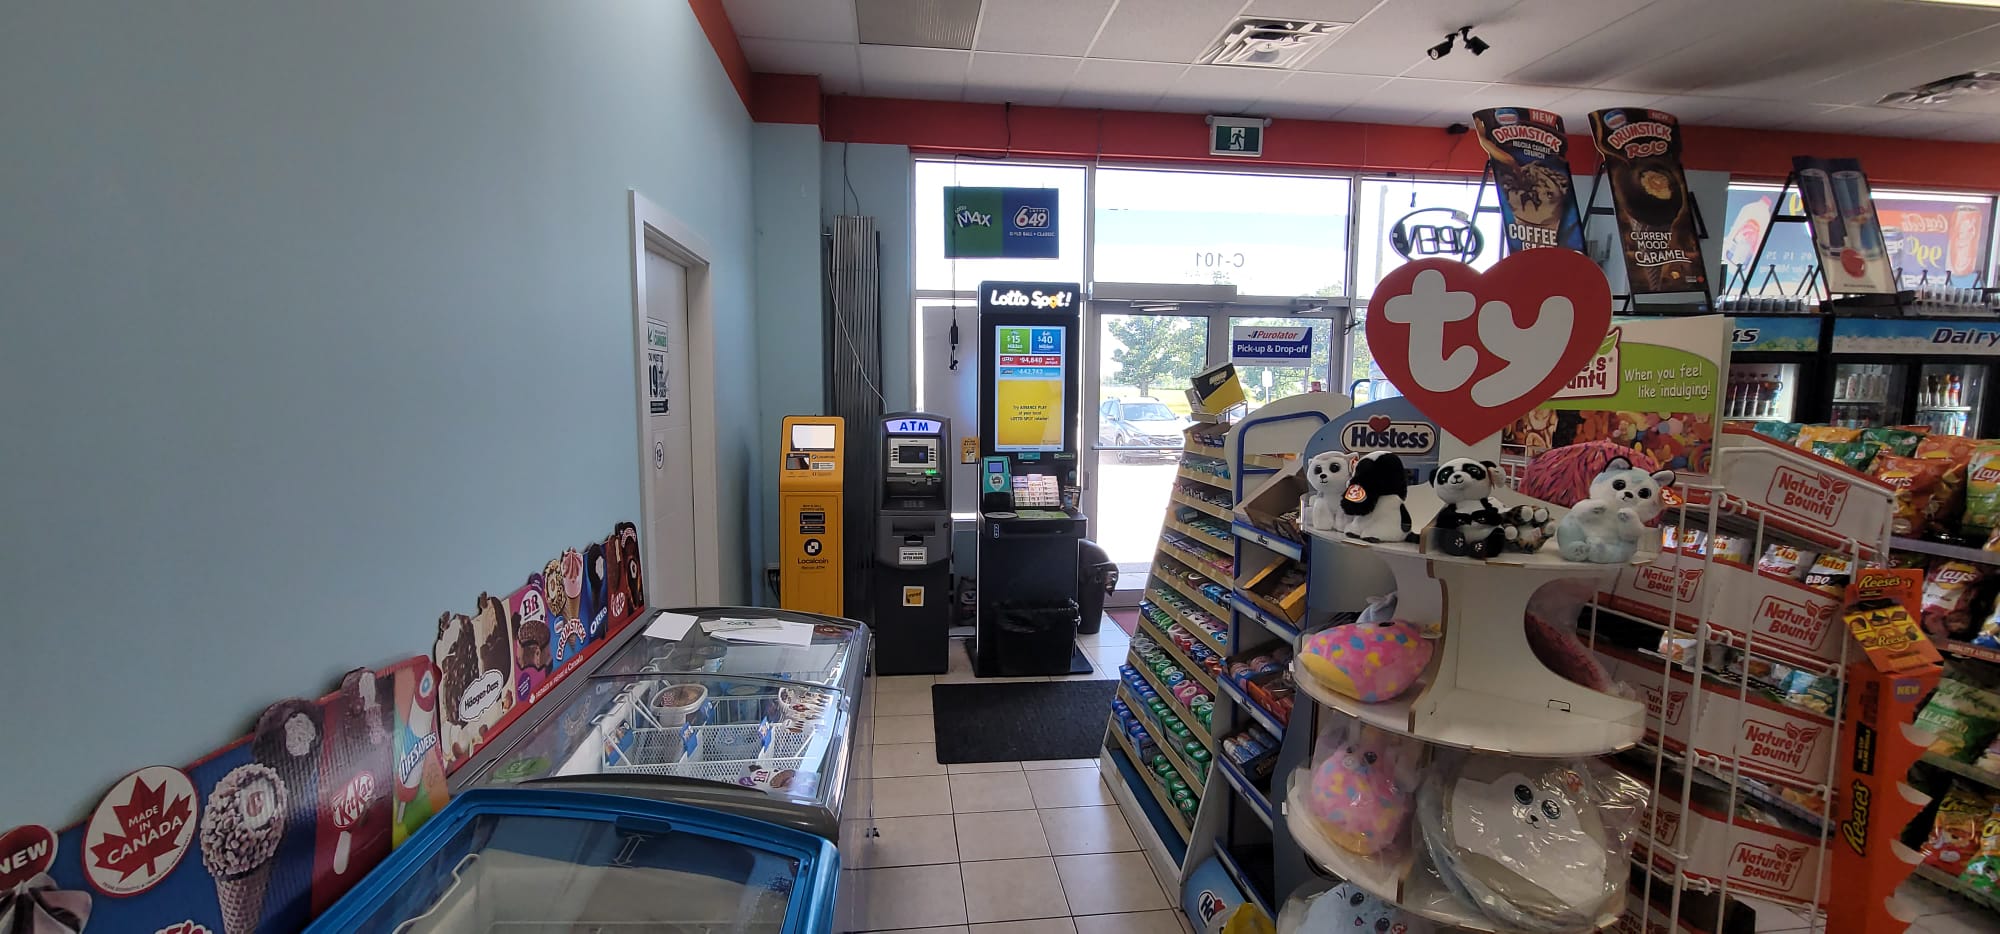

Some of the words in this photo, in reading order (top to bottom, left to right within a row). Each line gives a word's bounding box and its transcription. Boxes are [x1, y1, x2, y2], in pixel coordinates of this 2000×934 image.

[1532, 111, 1554, 123] NEW
[1492, 125, 1562, 152] DRUMSTICK
[1608, 122, 1672, 150] DRUMSTICK
[956, 210, 991, 228] MAX
[1508, 223, 1558, 246] COFFEE
[1630, 231, 1673, 241] CURRENT
[1637, 240, 1670, 249] MOOD:
[1635, 249, 1689, 264] CARAMEL
[990, 289, 1030, 306] Lotto
[1031, 290, 1073, 309] Spot!
[1257, 330, 1298, 340] Purolator
[1384, 269, 1575, 408] ty
[1932, 327, 2000, 346] Dairy
[1237, 344, 1266, 354] Pick-up
[1266, 345, 1274, 353] &
[1274, 344, 1309, 355] Drop-off
[1624, 368, 1653, 383] When
[1657, 369, 1675, 384] you
[1680, 362, 1702, 378] feel
[1638, 383, 1656, 398] like
[1660, 382, 1711, 400] indulging!
[899, 421, 929, 432] ATM
[1351, 427, 1430, 449] Hostess
[1778, 471, 1837, 503] Nature's
[1784, 491, 1833, 520] Bounty
[1859, 575, 1901, 589] Reese's
[1935, 567, 1977, 584] Lay's
[522, 595, 540, 616] BR
[1764, 600, 1822, 631] Nature's
[590, 606, 608, 635] OREO
[555, 618, 587, 661] DRUMSTICK
[1769, 620, 1818, 647] Bounty
[1746, 724, 1809, 753] Nature's
[1751, 744, 1801, 768] Bounty
[128, 804, 160, 829] MADE
[139, 819, 151, 833] IN
[106, 815, 183, 865] CANADA
[0, 839, 48, 876] NEW
[1738, 848, 1798, 877] Nature's
[1743, 865, 1789, 886] Bounty
